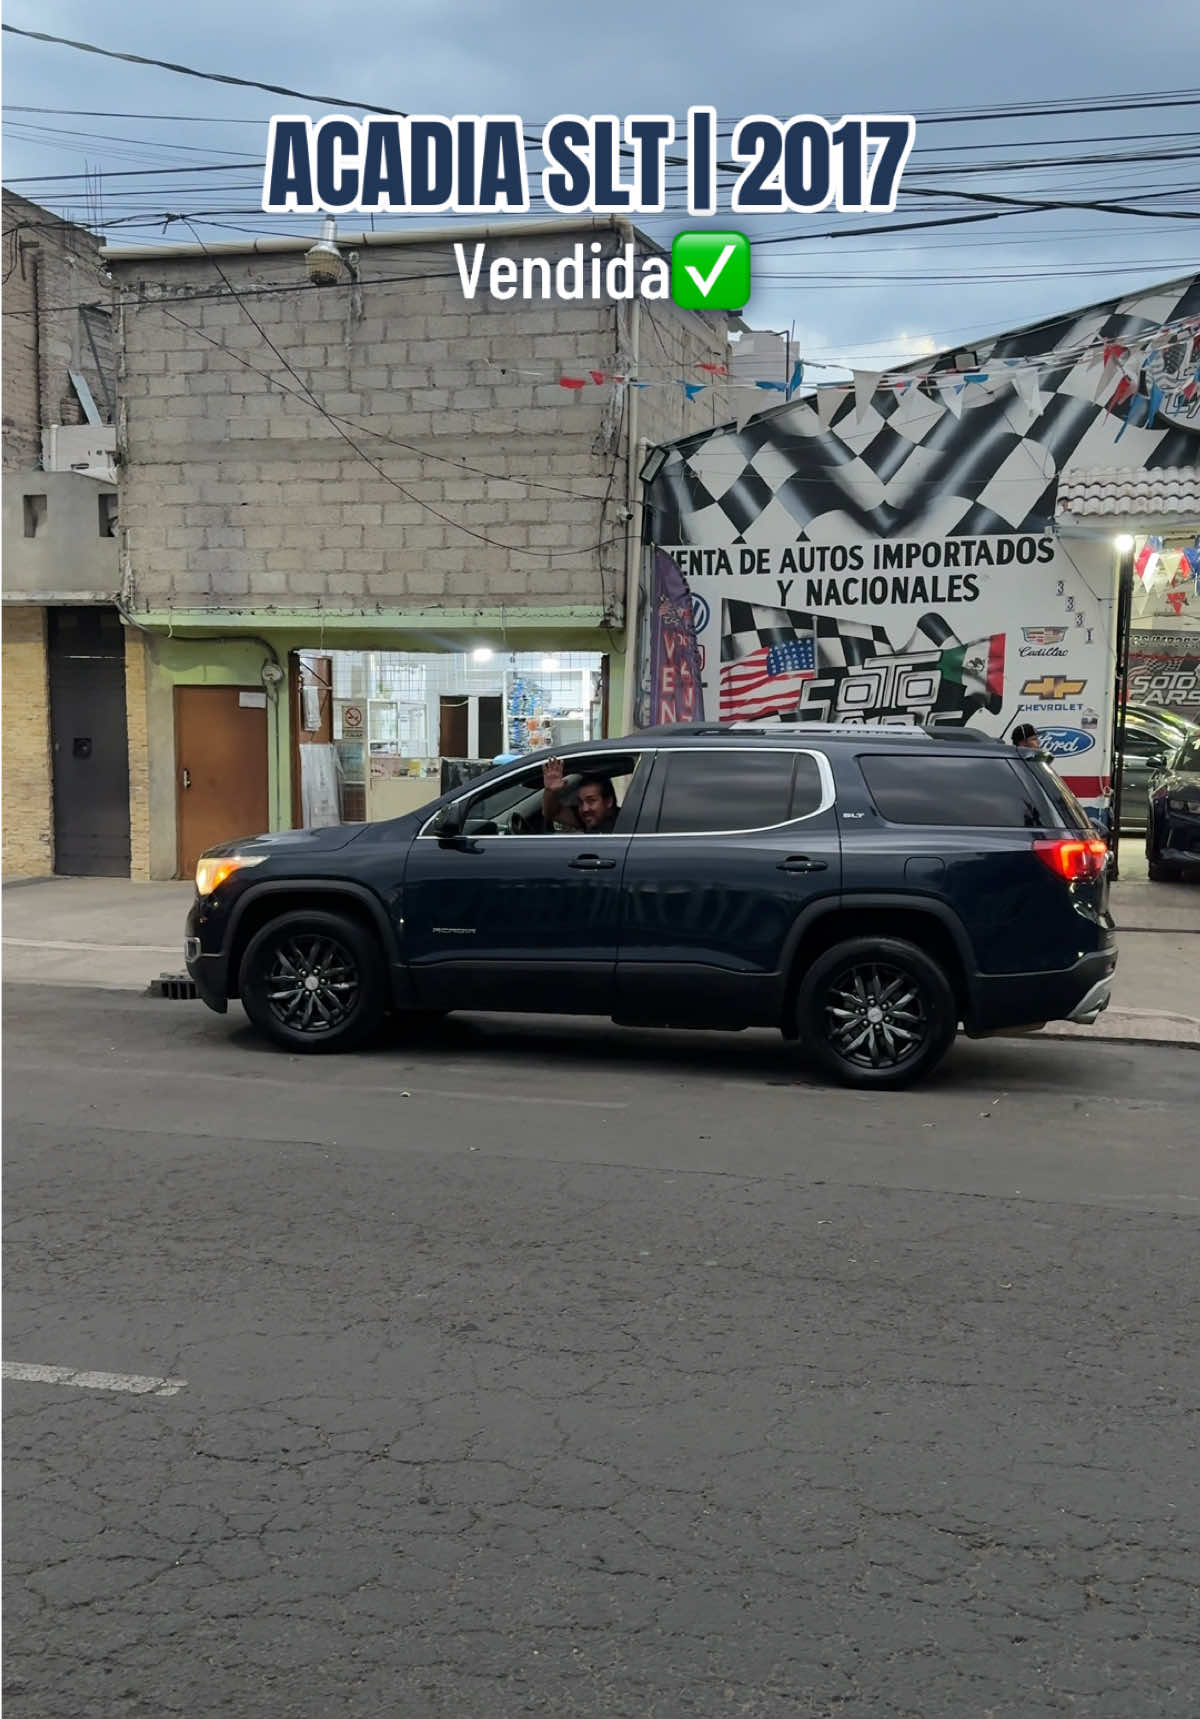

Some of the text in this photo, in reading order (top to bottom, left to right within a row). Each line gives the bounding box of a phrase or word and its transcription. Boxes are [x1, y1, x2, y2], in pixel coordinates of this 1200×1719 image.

[671, 536, 1056, 576] ENTA DE AUTOS IMPORTADOS
[777, 573, 980, 607] Y NACIONALES
[1018, 646, 1069, 657] Cadillac
[798, 651, 942, 723] SOTO
[1130, 671, 1197, 692] SOTO
[1018, 703, 1084, 712] CHEVROLET
